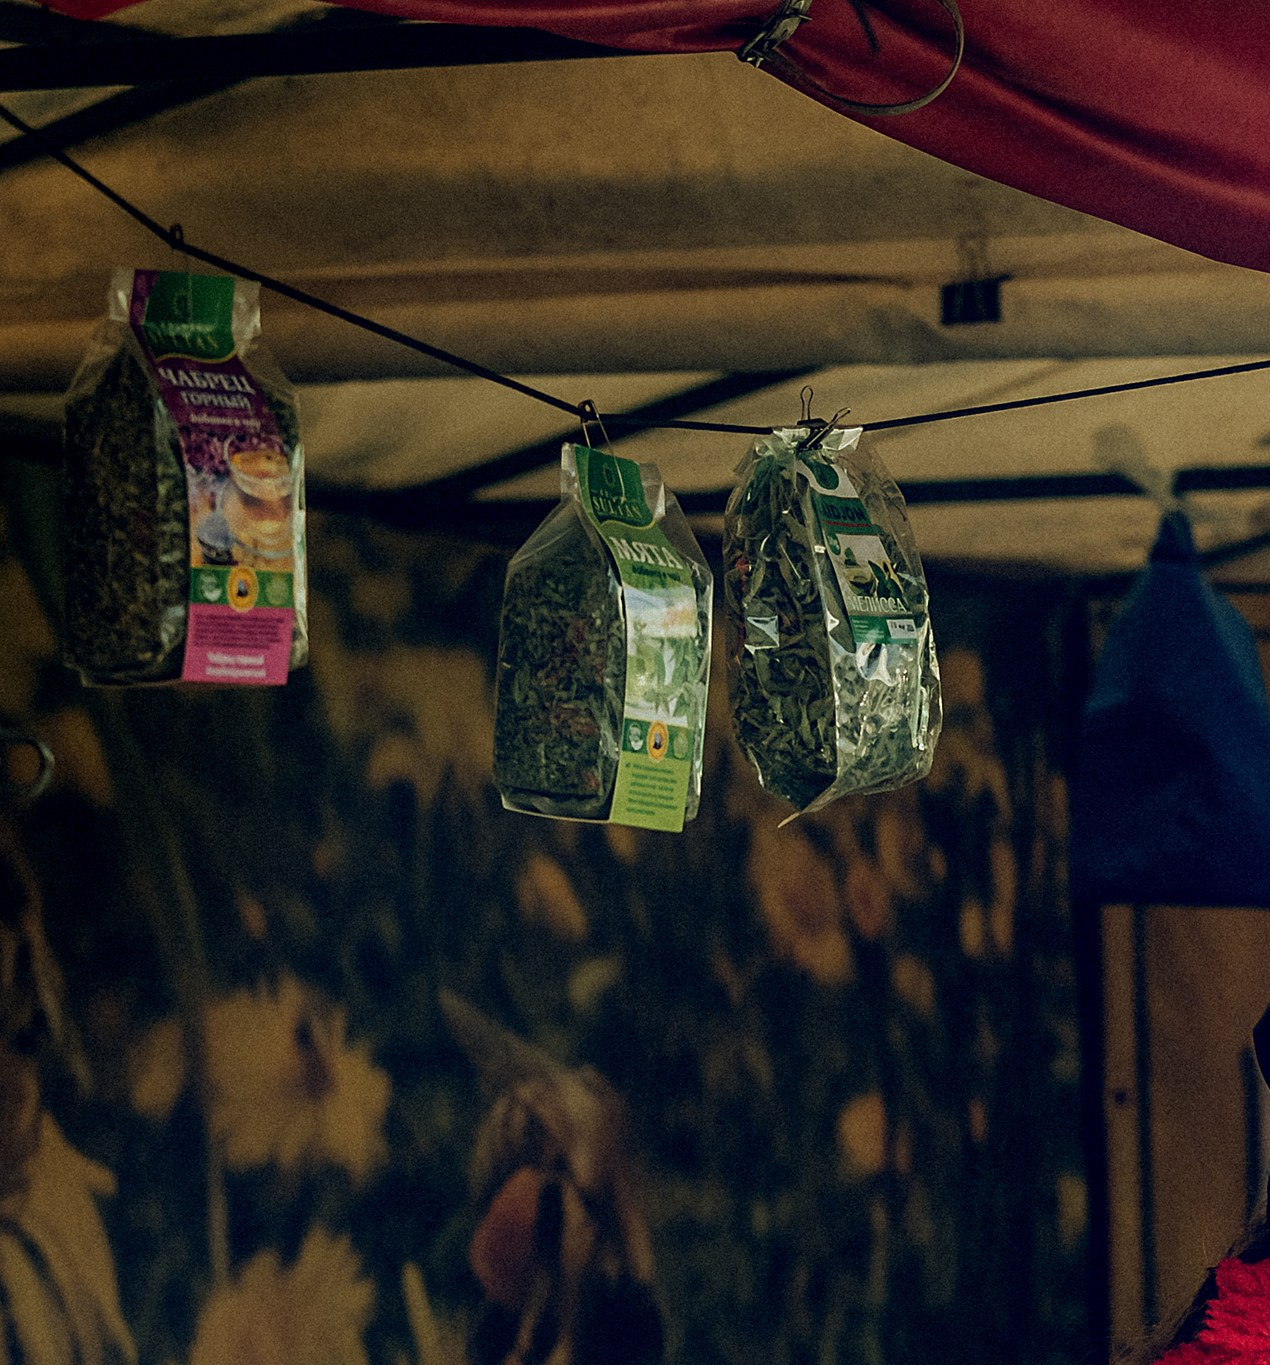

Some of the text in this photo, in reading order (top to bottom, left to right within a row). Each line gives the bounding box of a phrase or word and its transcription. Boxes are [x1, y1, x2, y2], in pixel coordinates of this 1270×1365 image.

[158, 367, 256, 394] ЧАБРЕЦ
[609, 536, 684, 570] МЯТА
[848, 596, 907, 613] МЕЛИССА
